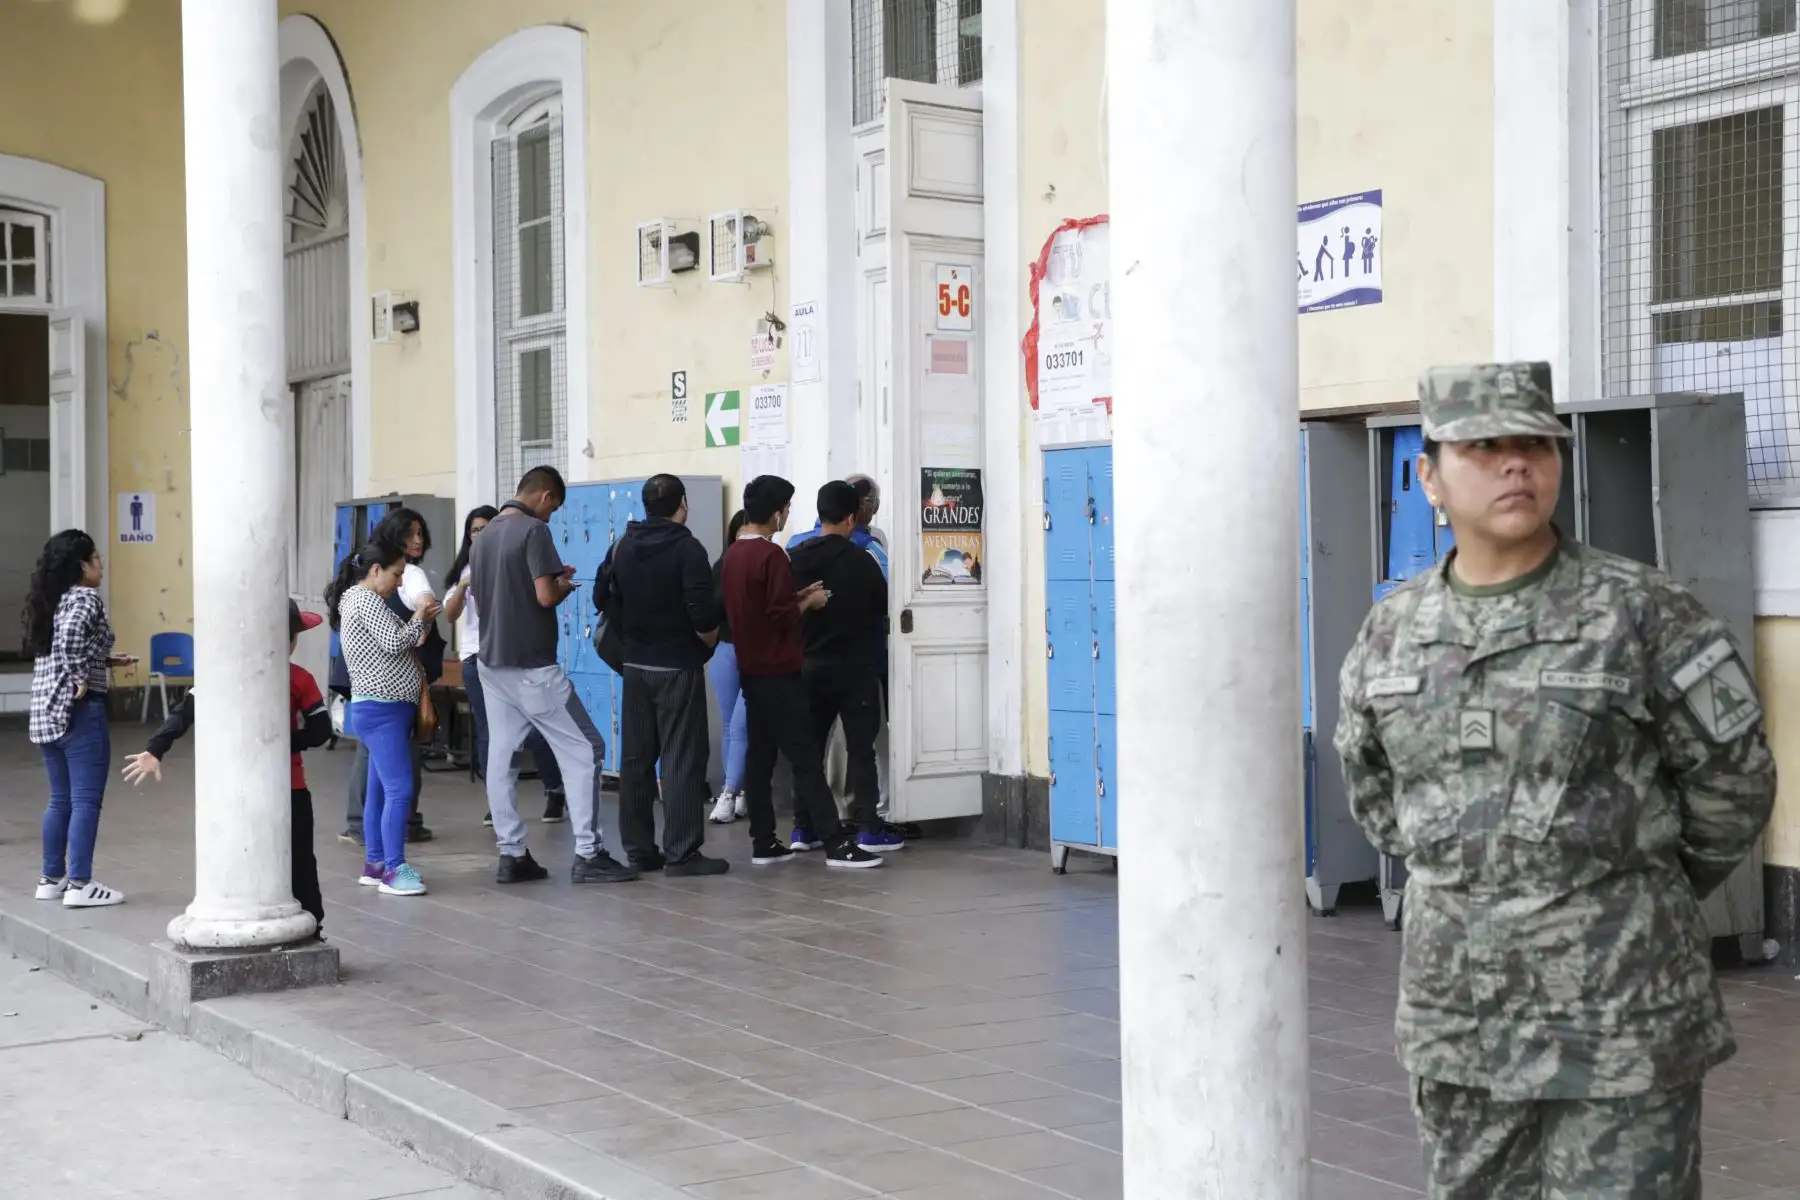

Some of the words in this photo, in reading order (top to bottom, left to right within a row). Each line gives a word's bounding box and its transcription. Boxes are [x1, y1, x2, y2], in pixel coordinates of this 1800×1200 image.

[939, 283, 970, 317] 5-C
[794, 304, 814, 317] AULA
[1046, 350, 1083, 370] 033701
[674, 372, 685, 398] S
[755, 394, 782, 410] 033700
[923, 506, 980, 524] GRANDES
[120, 531, 154, 542] BAÑO
[924, 535, 980, 549] AVENTURAS
